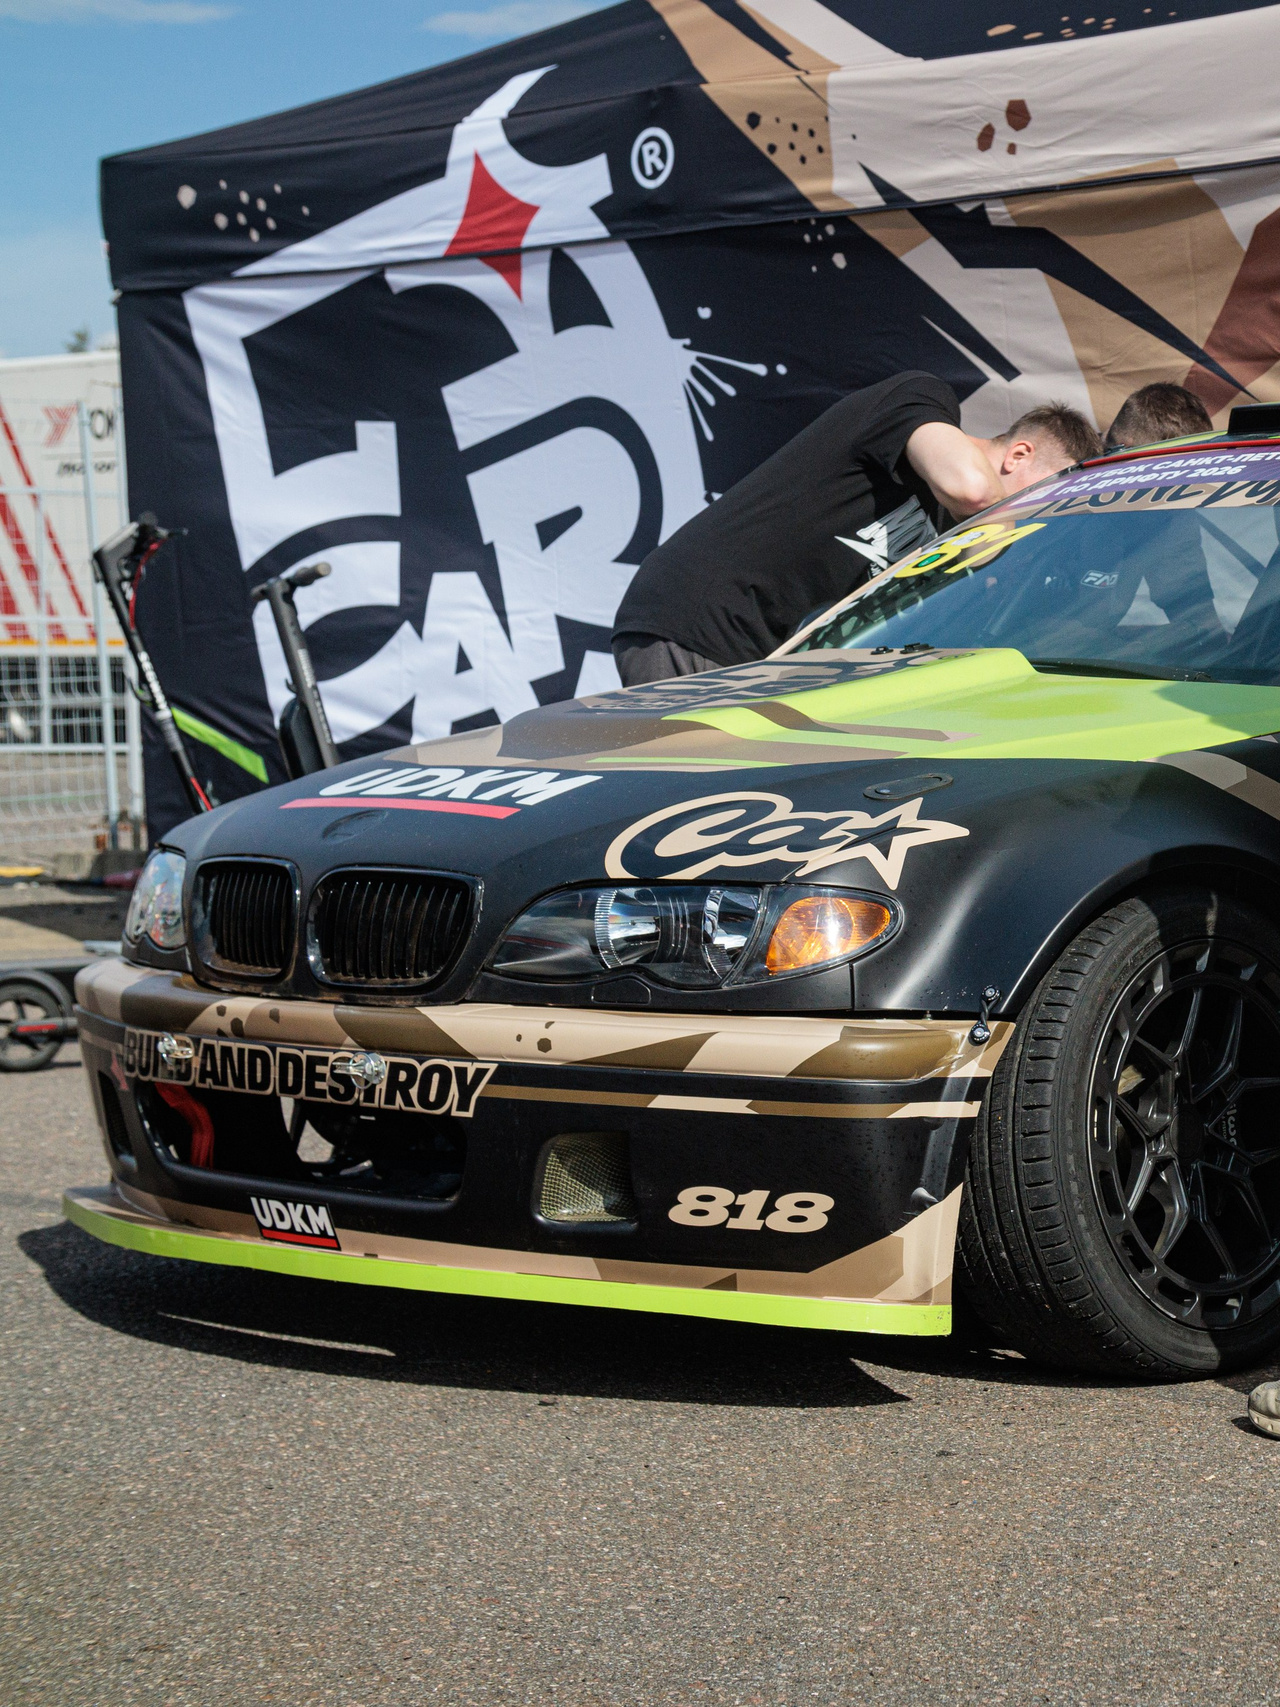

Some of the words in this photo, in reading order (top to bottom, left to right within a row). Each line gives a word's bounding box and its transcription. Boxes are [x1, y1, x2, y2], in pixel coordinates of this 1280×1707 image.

[1074, 462, 1153, 482] КУБОК
[1092, 468, 1186, 490] ДРИФТУ
[1186, 464, 1247, 479] 2026
[318, 767, 603, 806] UDKM
[196, 1038, 275, 1096] AND
[251, 1197, 334, 1239] UDKM
[668, 1186, 836, 1234] 818
